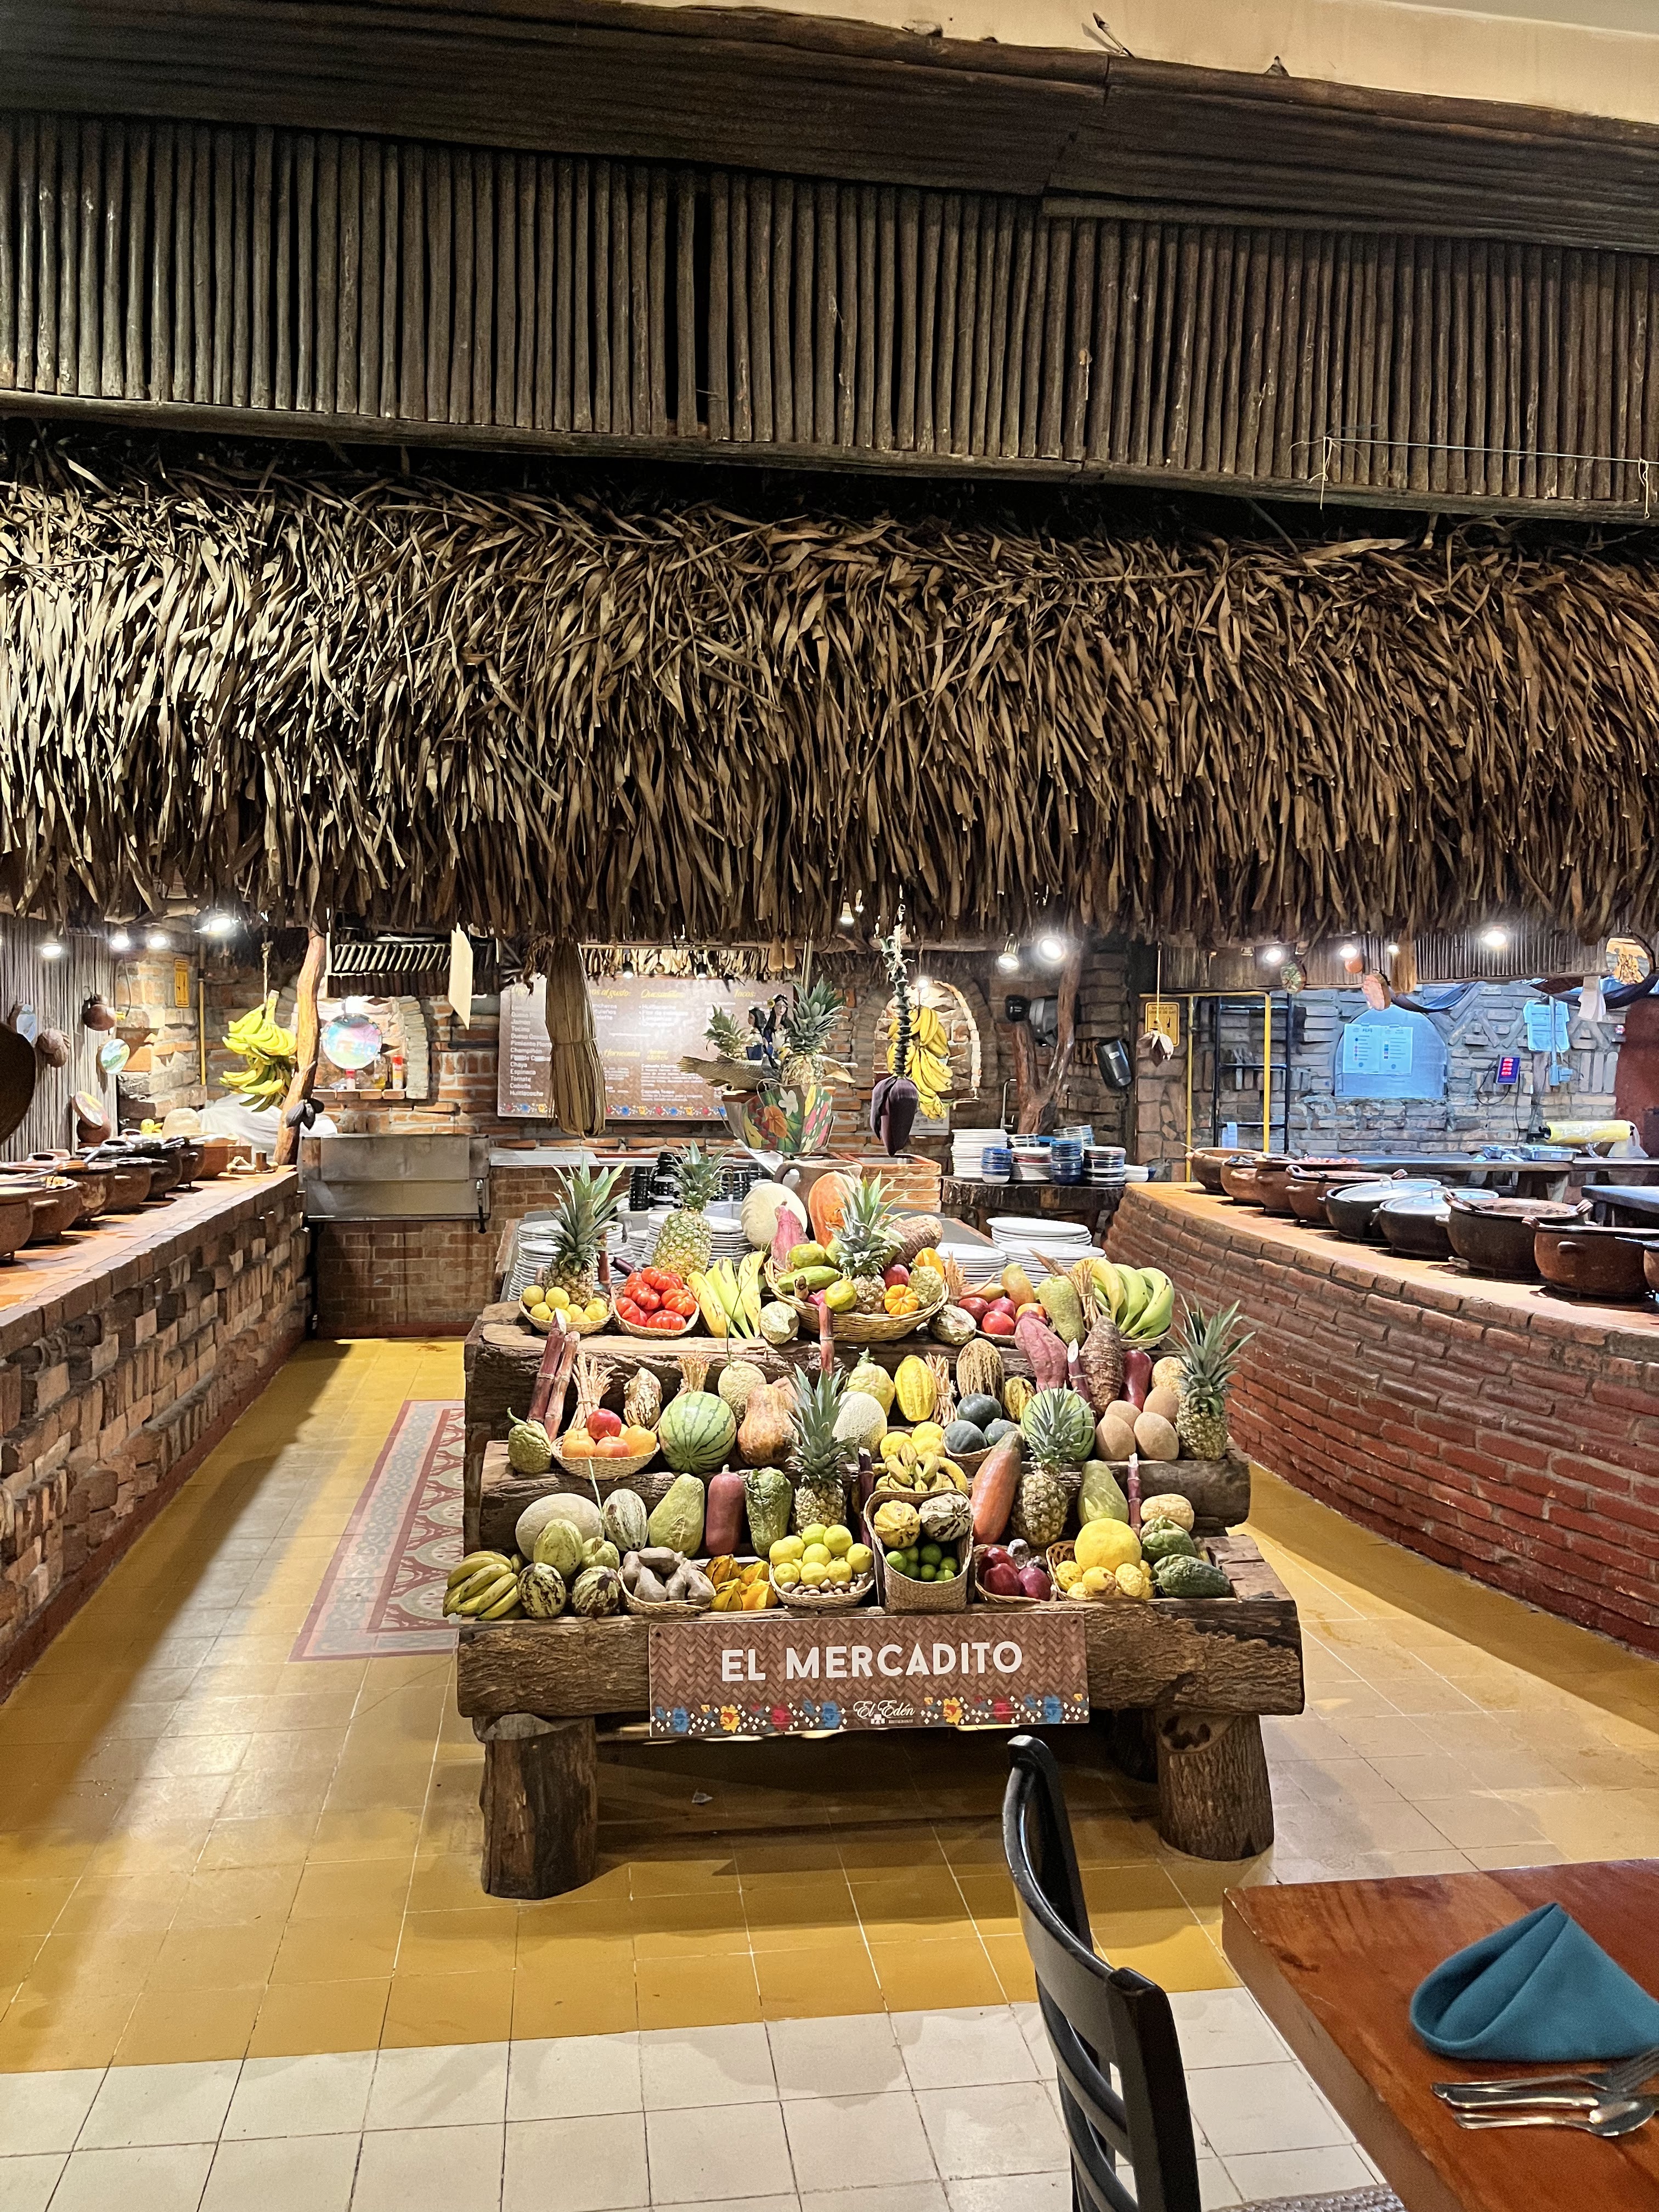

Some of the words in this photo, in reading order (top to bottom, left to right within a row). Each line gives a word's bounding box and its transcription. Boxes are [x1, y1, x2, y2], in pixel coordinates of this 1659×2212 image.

[721, 1649, 766, 1681] EL
[786, 1641, 1023, 1679] MERCADITO
[853, 1701, 876, 1719] El
[878, 1700, 916, 1718] Edén
